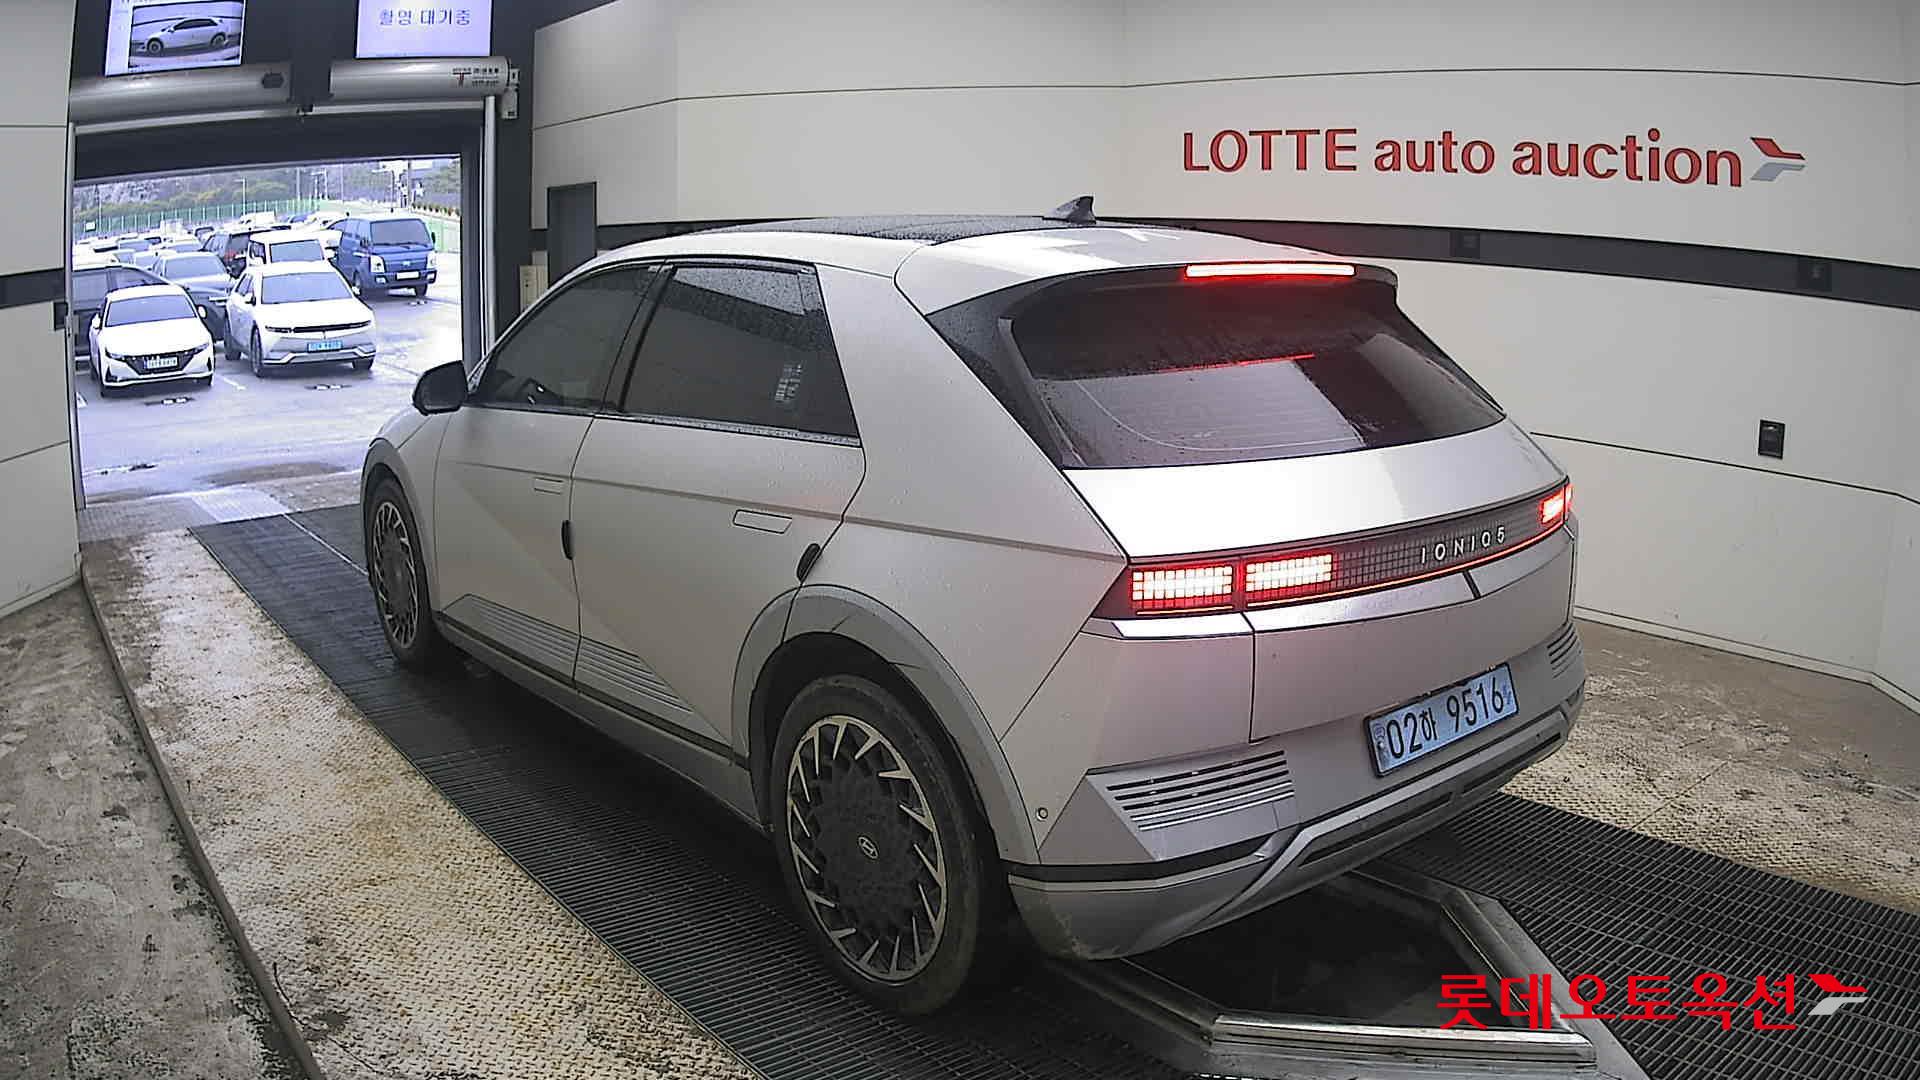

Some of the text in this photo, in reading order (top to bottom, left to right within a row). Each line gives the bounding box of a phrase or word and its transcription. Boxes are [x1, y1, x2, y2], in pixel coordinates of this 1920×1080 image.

[1184, 128, 1742, 187] LOTTE auto auction
[1386, 707, 1438, 759] 02하
[1446, 676, 1504, 732] 9516
